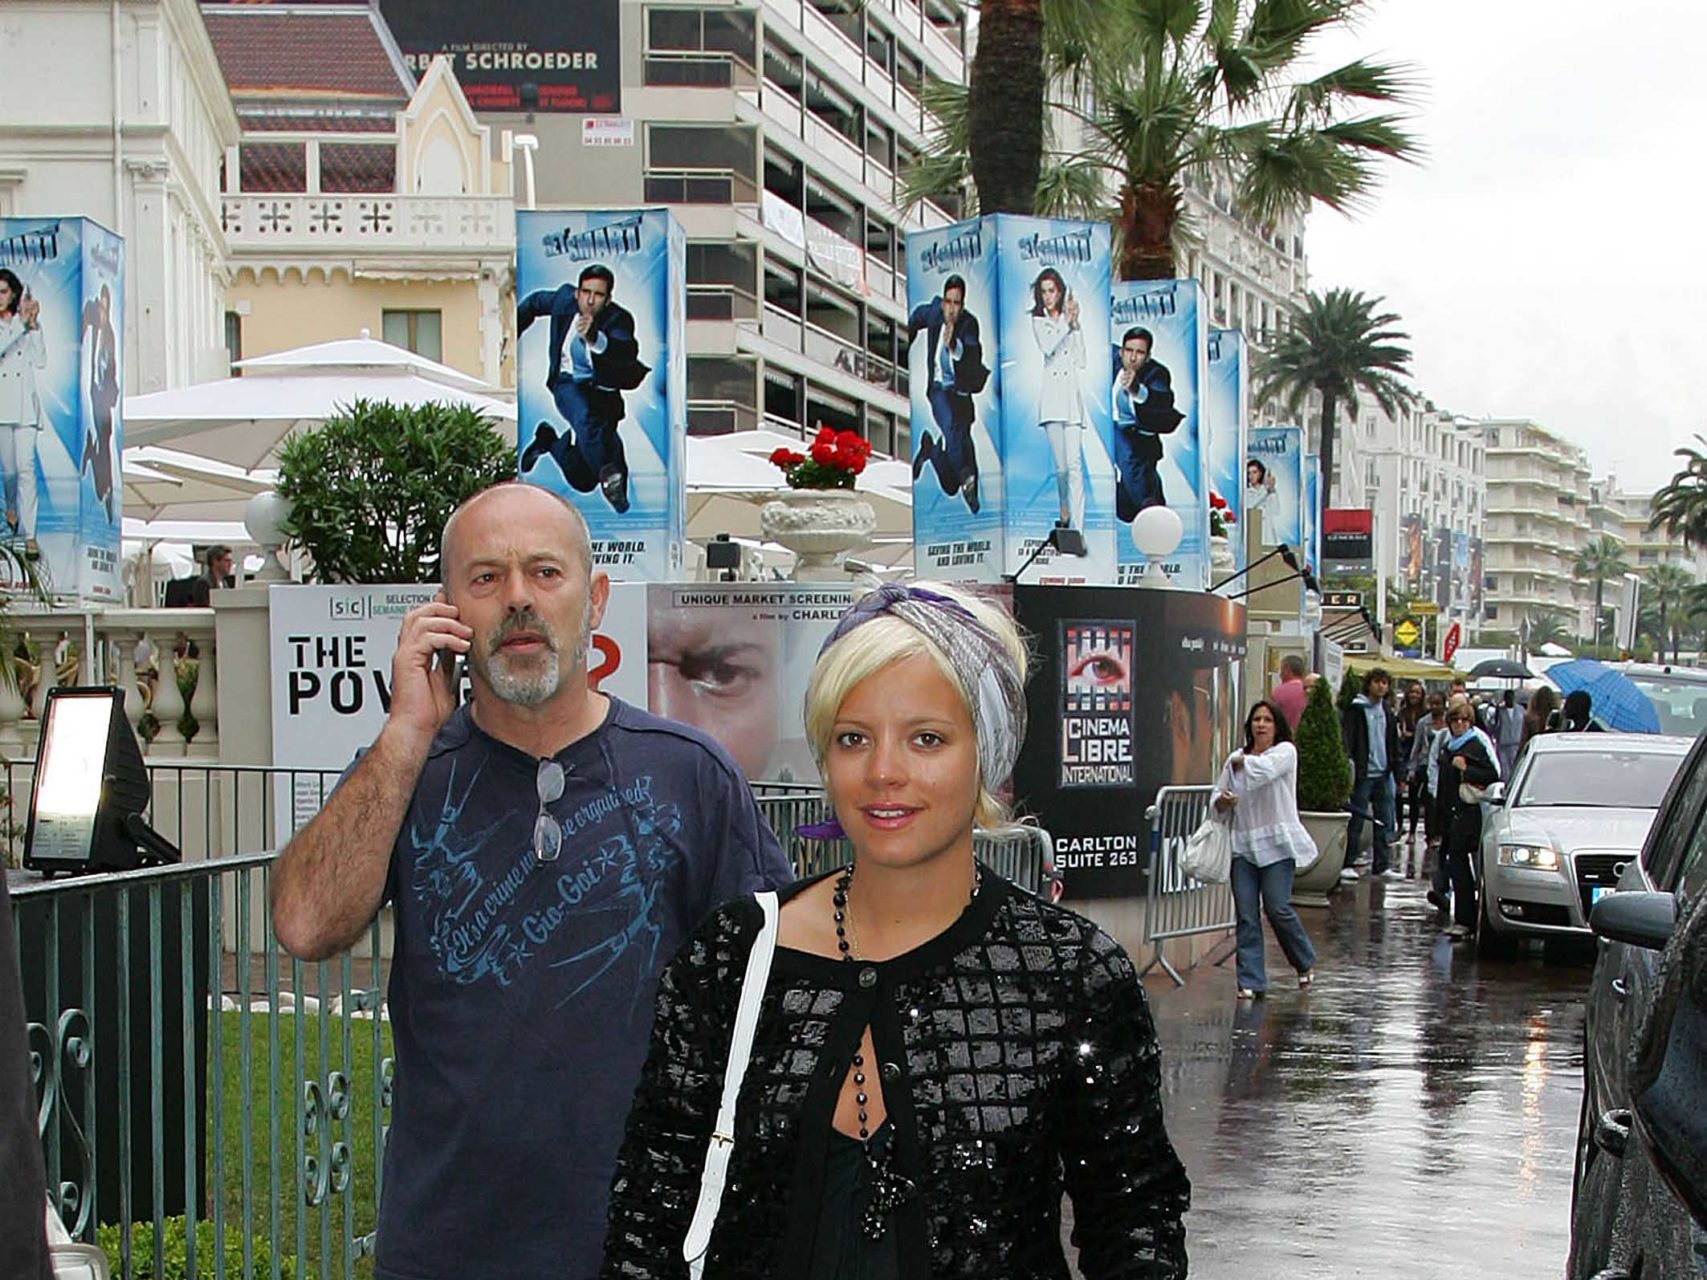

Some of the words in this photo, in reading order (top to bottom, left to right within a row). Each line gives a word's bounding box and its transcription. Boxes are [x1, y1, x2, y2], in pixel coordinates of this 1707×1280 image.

[473, 43, 514, 51] DIRECTED
[466, 53, 599, 69] SCHROEDER
[608, 541, 646, 552] WORLD.
[386, 594, 430, 604] SELECTION
[681, 595, 729, 605] UNIQUE
[733, 595, 784, 604] MARKET
[789, 594, 852, 604] SCREENIN
[778, 612, 789, 621] by
[288, 636, 367, 668] THE
[1068, 718, 1130, 738] CINEMA
[1063, 719, 1132, 762] LIBRE
[1062, 765, 1132, 782] INTERNATIONAL
[1056, 836, 1137, 852] CARLTON
[1056, 853, 1103, 868] SUITE
[1110, 852, 1137, 866] 263
[522, 860, 601, 944] Gio-Goi
